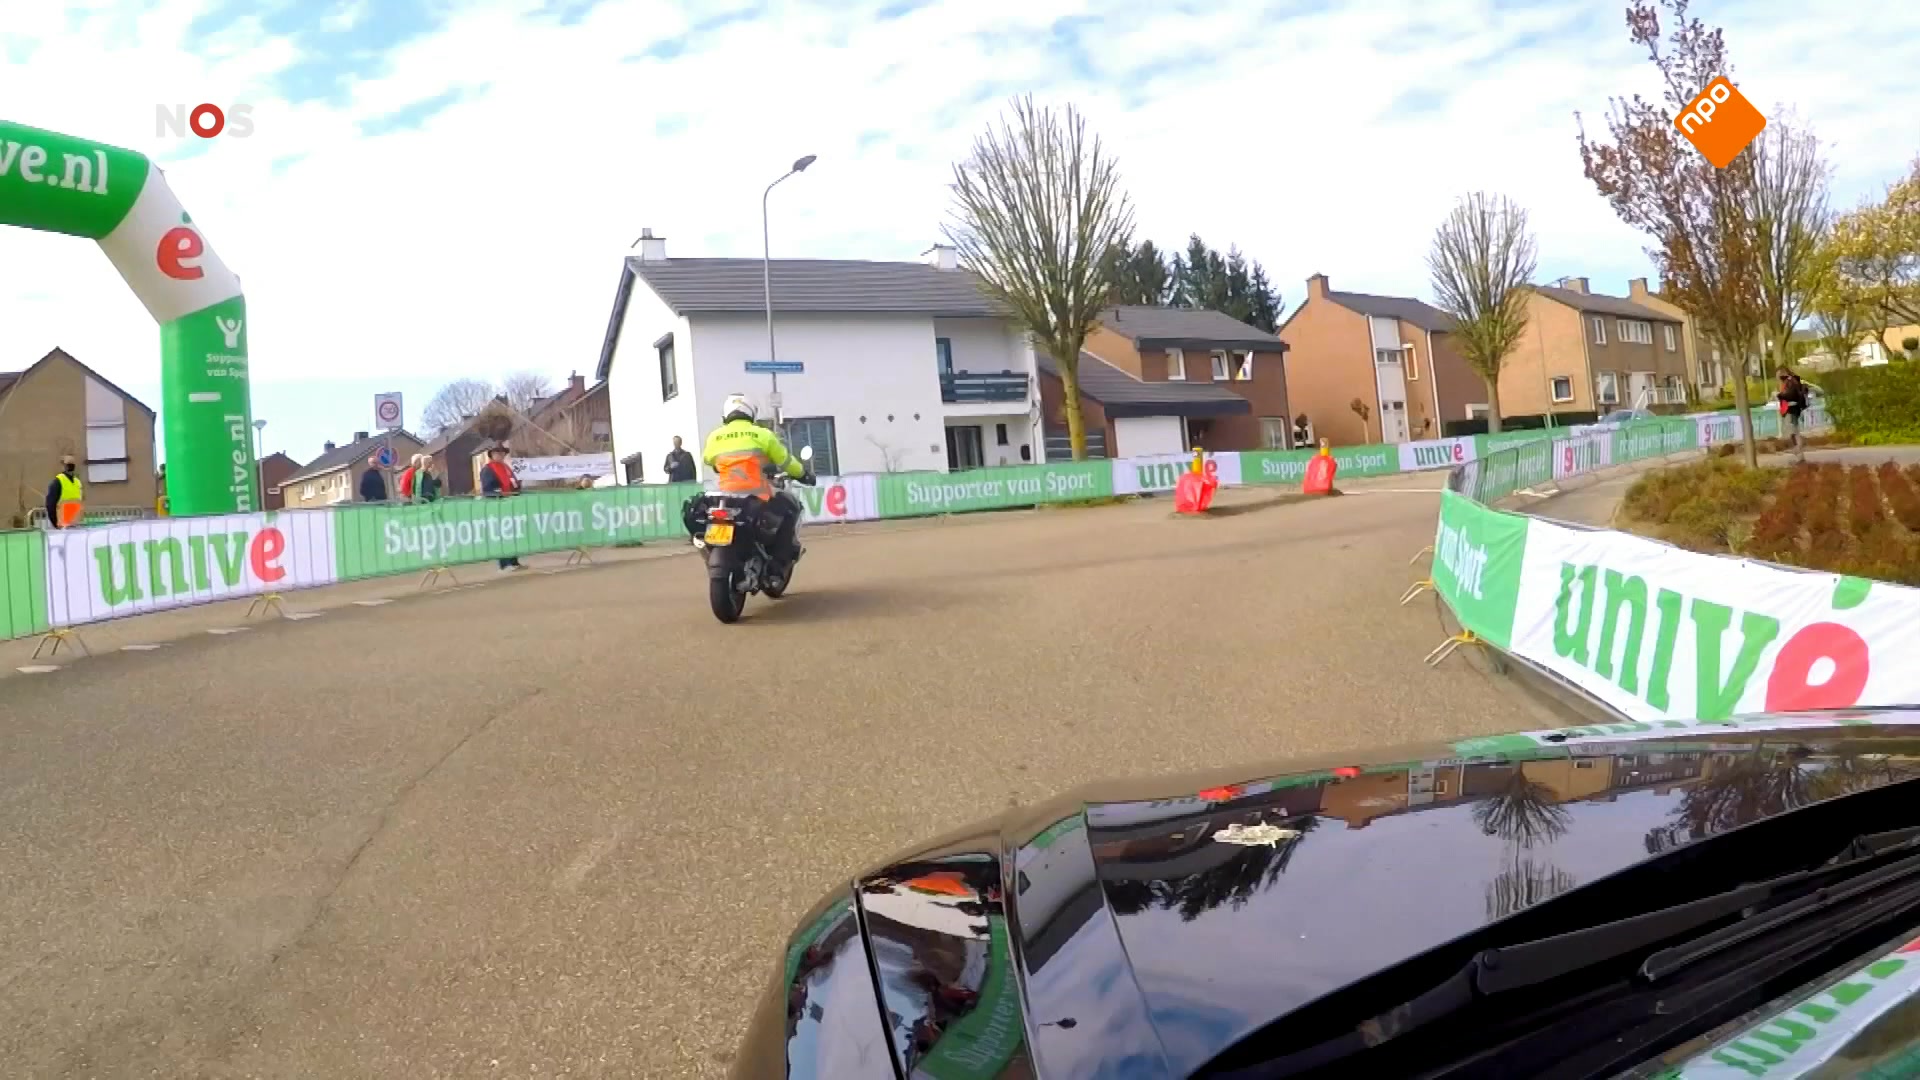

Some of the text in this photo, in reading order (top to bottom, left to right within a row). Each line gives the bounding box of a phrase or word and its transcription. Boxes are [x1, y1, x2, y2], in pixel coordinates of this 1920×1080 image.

[0, 139, 109, 195] ve.nl
[224, 414, 250, 512] nive.nl
[907, 471, 1094, 506] Supporter van Sport
[1262, 459, 1305, 480] Suppo
[1355, 453, 1387, 472] Sport
[384, 500, 665, 559] Supporter van Sport
